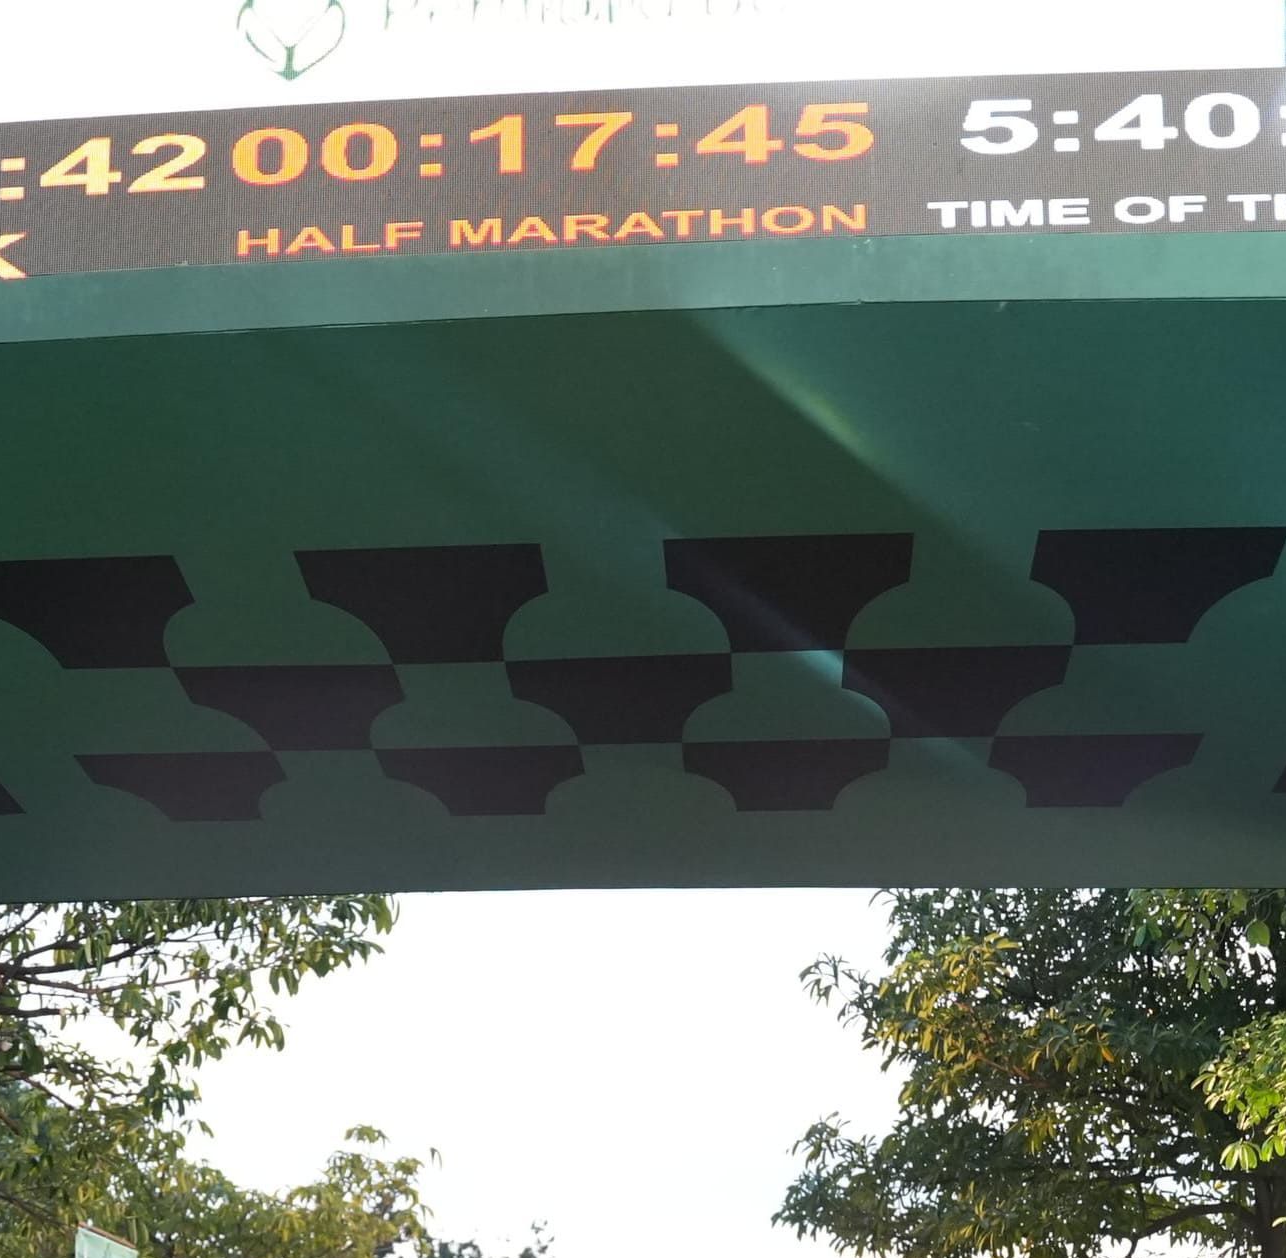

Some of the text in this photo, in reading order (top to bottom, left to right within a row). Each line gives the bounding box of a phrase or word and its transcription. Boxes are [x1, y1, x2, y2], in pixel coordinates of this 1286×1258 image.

[231, 101, 874, 186] 00:17:45
[236, 203, 867, 257] HALF MARATHON
[927, 198, 1090, 228] TIME
[1114, 192, 1206, 224] OF
